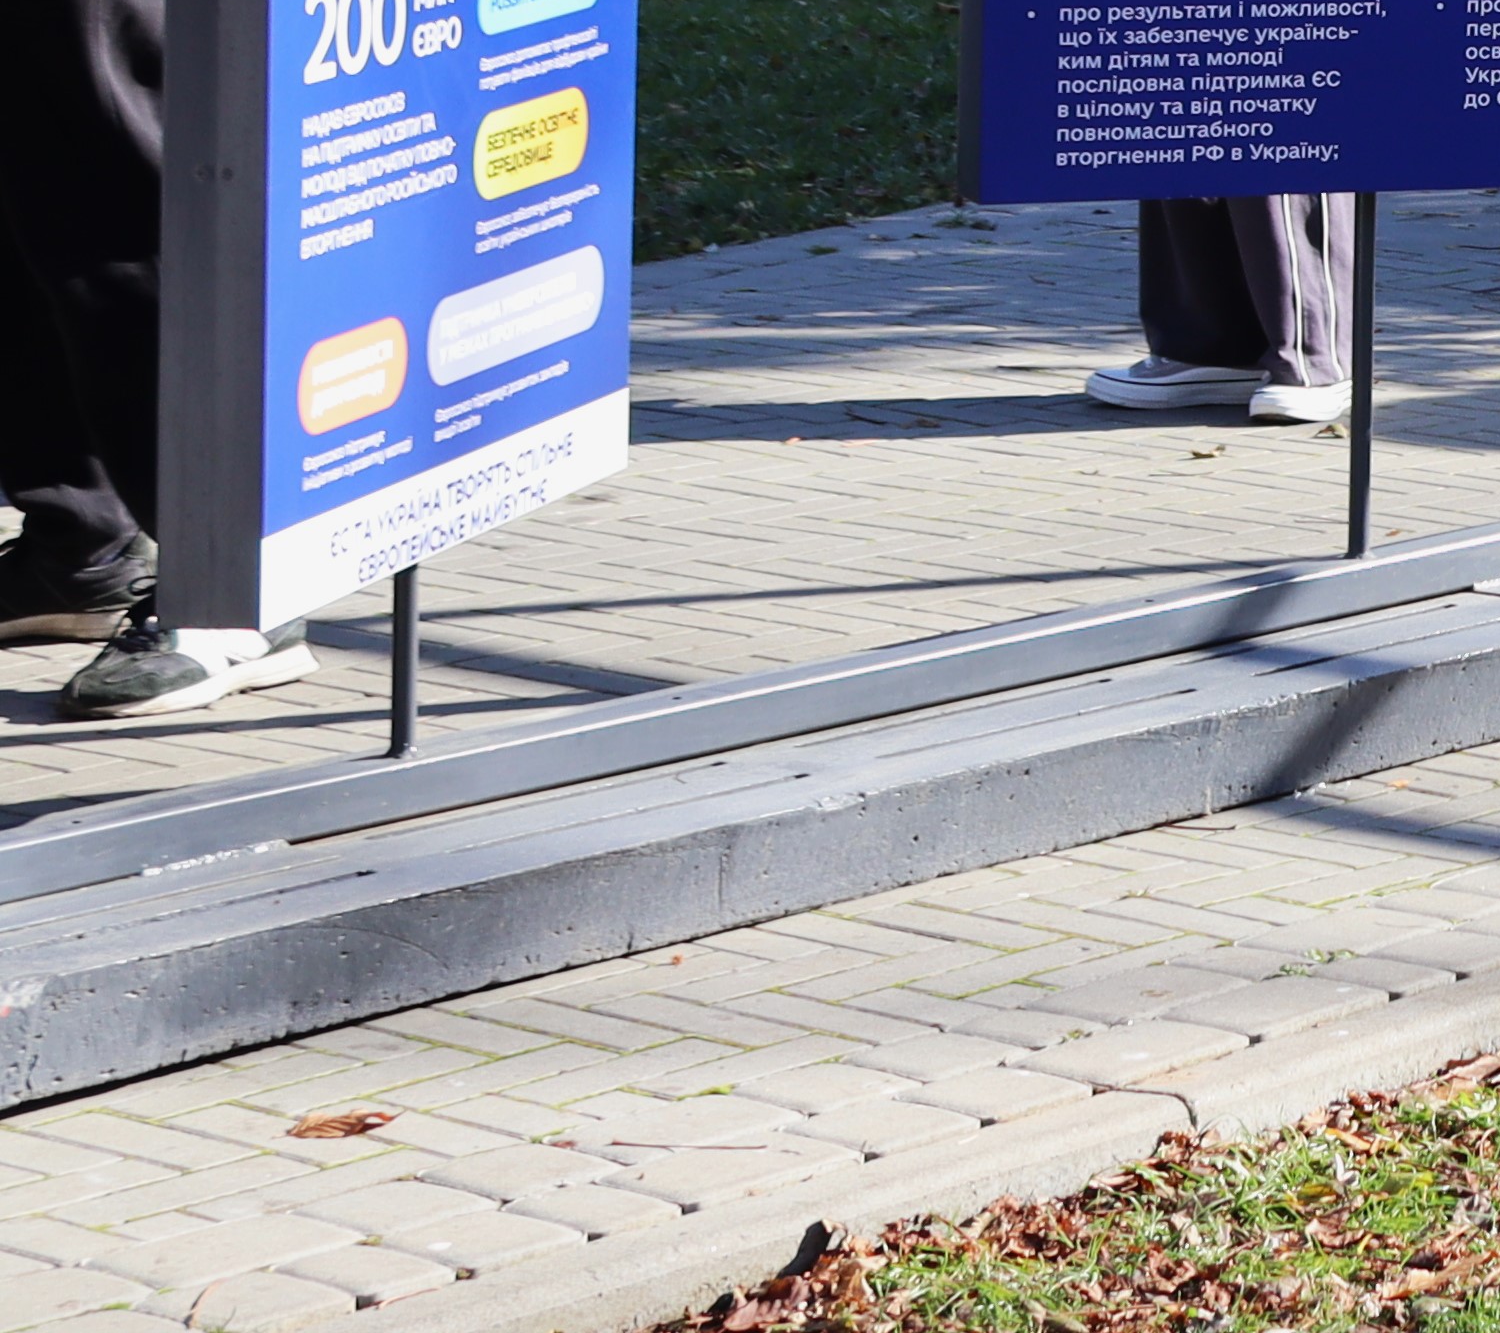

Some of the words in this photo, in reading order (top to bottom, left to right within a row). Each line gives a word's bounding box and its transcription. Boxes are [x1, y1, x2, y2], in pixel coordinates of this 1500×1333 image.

[1059, 7, 1102, 26] про
[1107, 4, 1232, 25] результати
[1238, 0, 1244, 18] і
[412, 15, 463, 58] ЄВРО
[1463, 92, 1491, 110] до
[1055, 148, 1185, 169] вторгнення
[1191, 144, 1225, 162] РФ
[1230, 147, 1243, 161] в
[1248, 141, 1339, 164] Україну;
[377, 488, 442, 534] УКРАЇНА
[447, 461, 512, 508] ТВОРЯТЬ
[358, 518, 466, 583] ЄВРОПЕЙСЬКЕ
